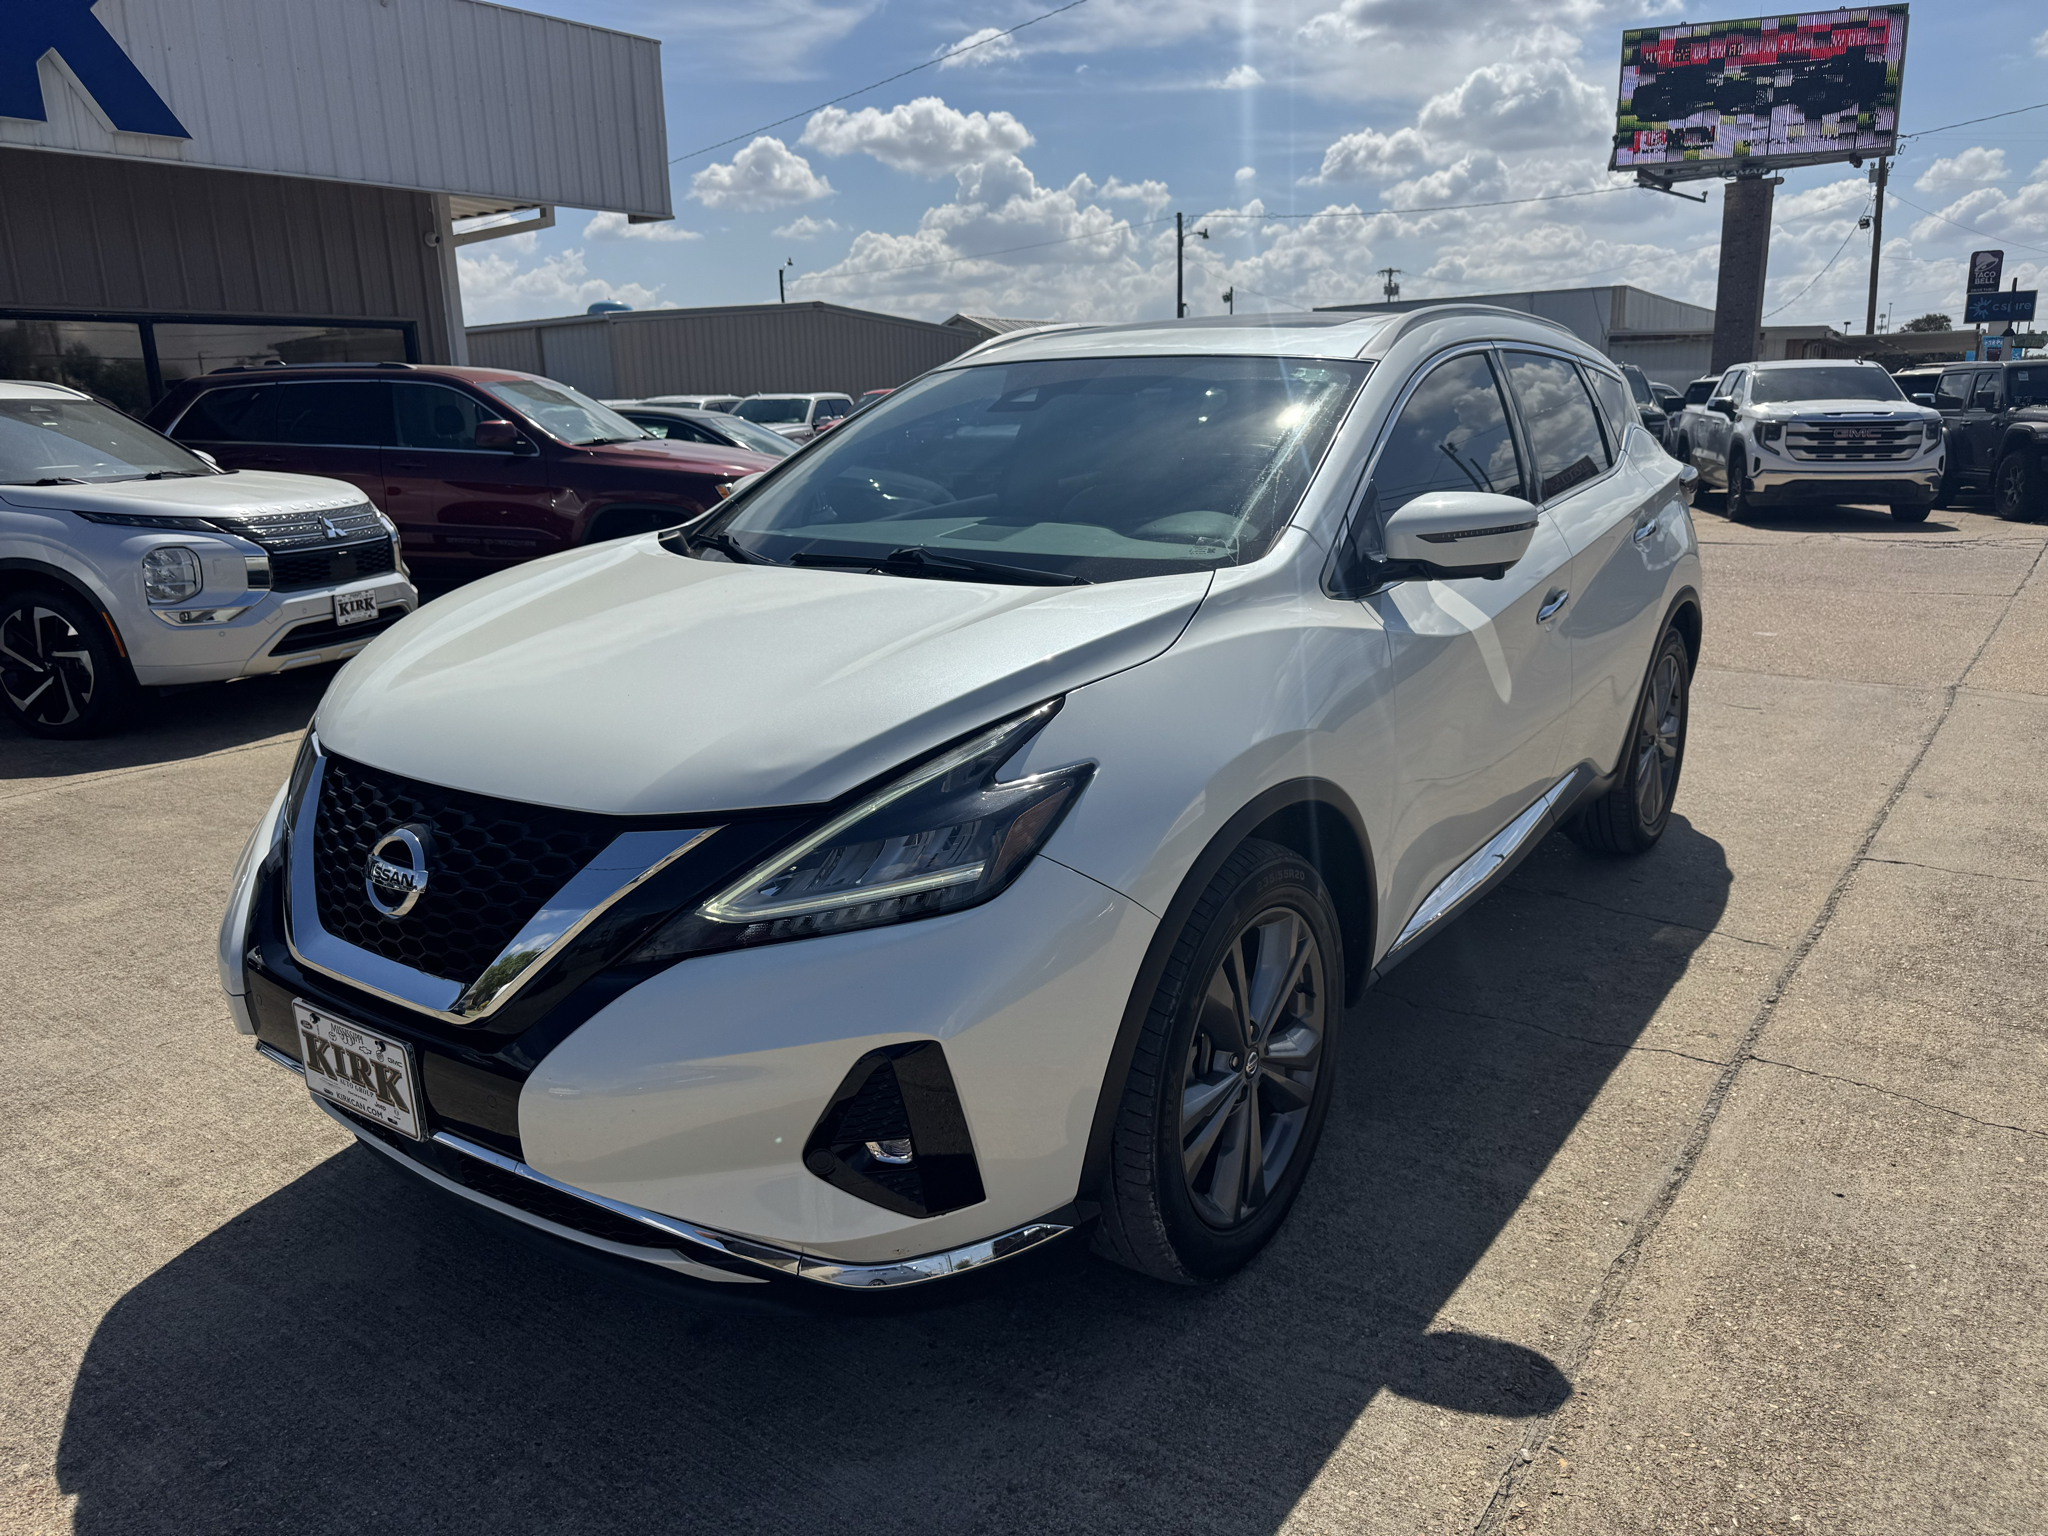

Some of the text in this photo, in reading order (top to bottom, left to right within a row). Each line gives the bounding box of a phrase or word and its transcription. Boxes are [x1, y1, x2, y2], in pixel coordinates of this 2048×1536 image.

[1721, 167, 1768, 177] LAMAR
[1974, 270, 1996, 278] TACO
[1974, 277, 1995, 285] BELL
[1833, 428, 1882, 438] GMC
[239, 498, 359, 515] OUTLANDER
[338, 597, 375, 617] KIRK
[1256, 869, 1305, 892] 235/55R20
[387, 1057, 403, 1068] GMC
[301, 1030, 410, 1114] KIRK
[354, 1084, 375, 1098] GROUP
